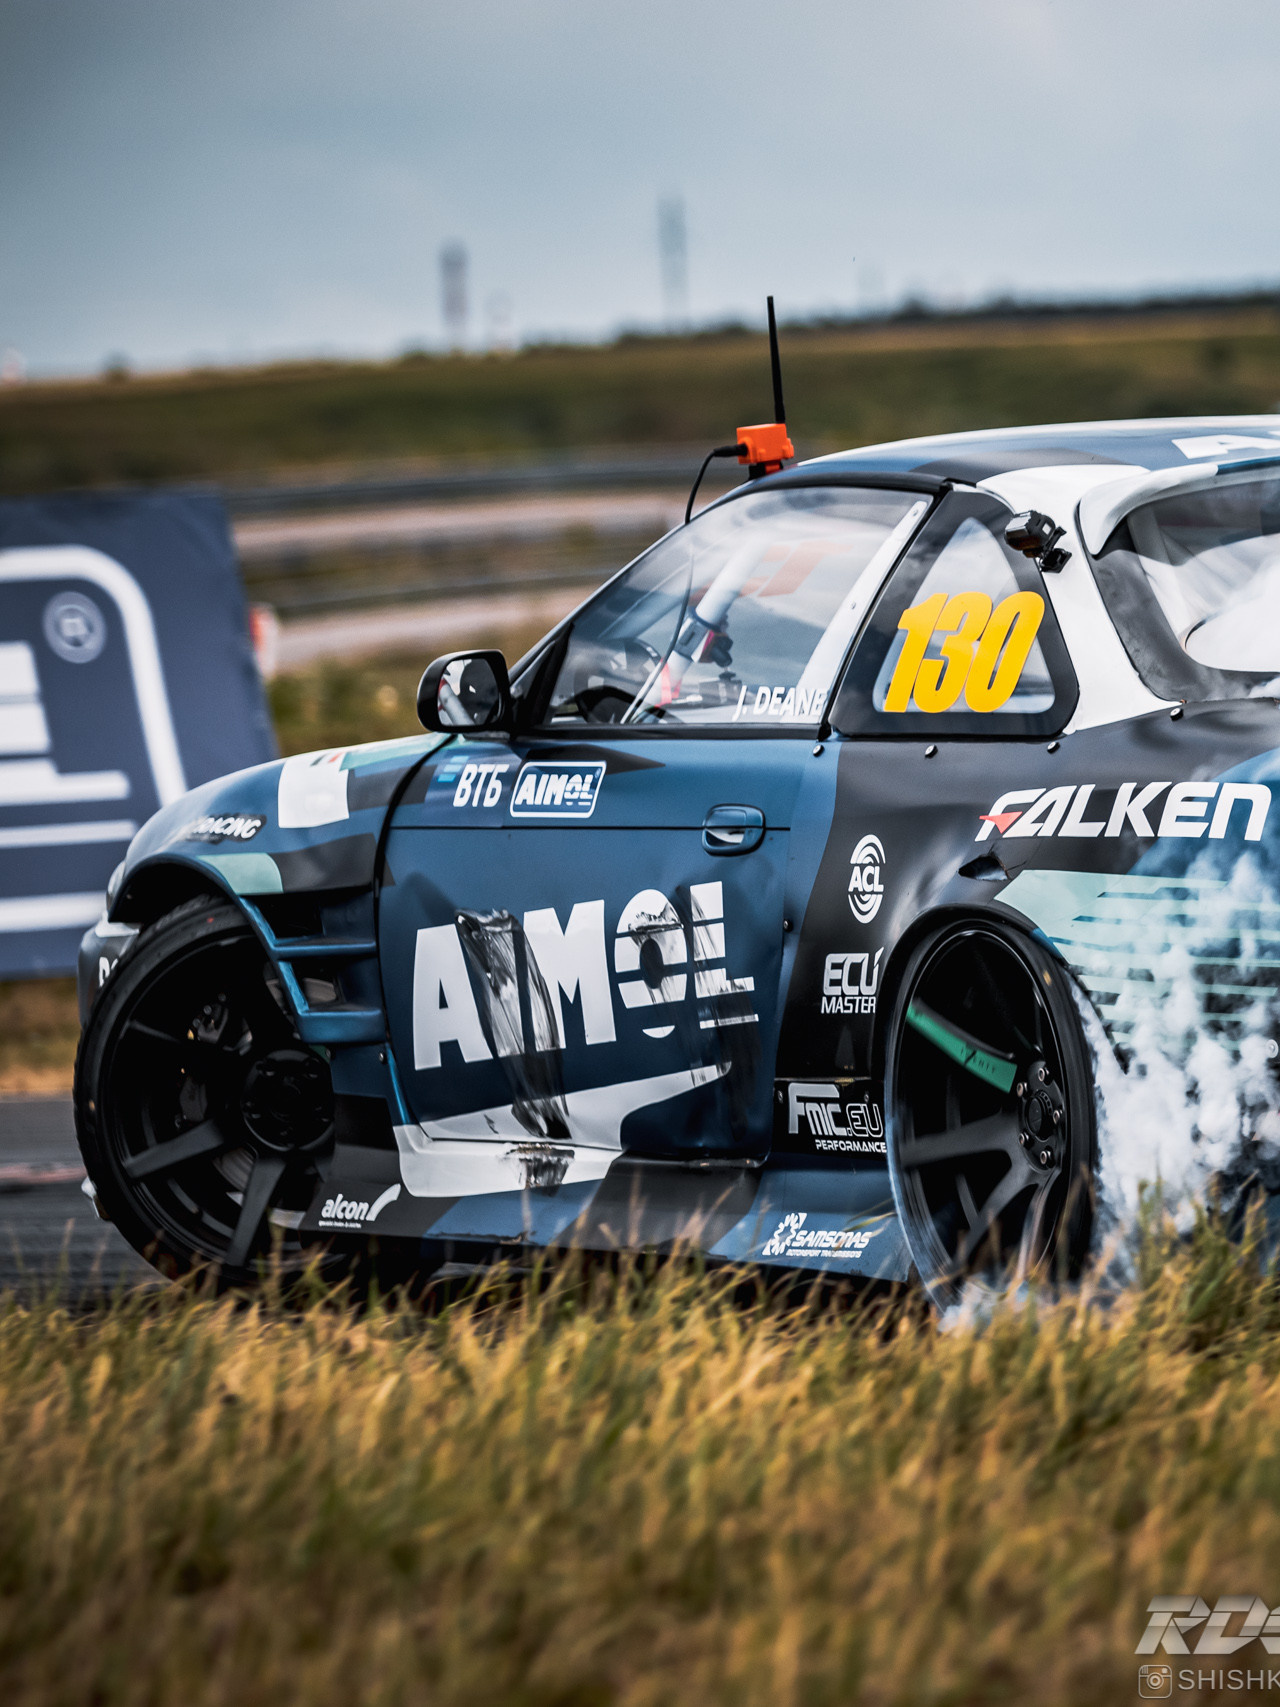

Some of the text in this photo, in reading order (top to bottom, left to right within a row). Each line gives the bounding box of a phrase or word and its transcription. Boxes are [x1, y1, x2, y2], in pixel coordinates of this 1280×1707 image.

[883, 590, 1045, 713] 130
[514, 773, 594, 806] AIMOL
[974, 781, 1272, 841] FALKEN
[848, 866, 885, 893] ACL
[412, 880, 760, 1071] AIMOL
[823, 947, 885, 996] ECU
[821, 996, 877, 1014] MASTER
[815, 1139, 888, 1153] PERFORMANCE
[321, 1193, 370, 1221] alcon
[791, 1230, 873, 1249] SAMSONAS
